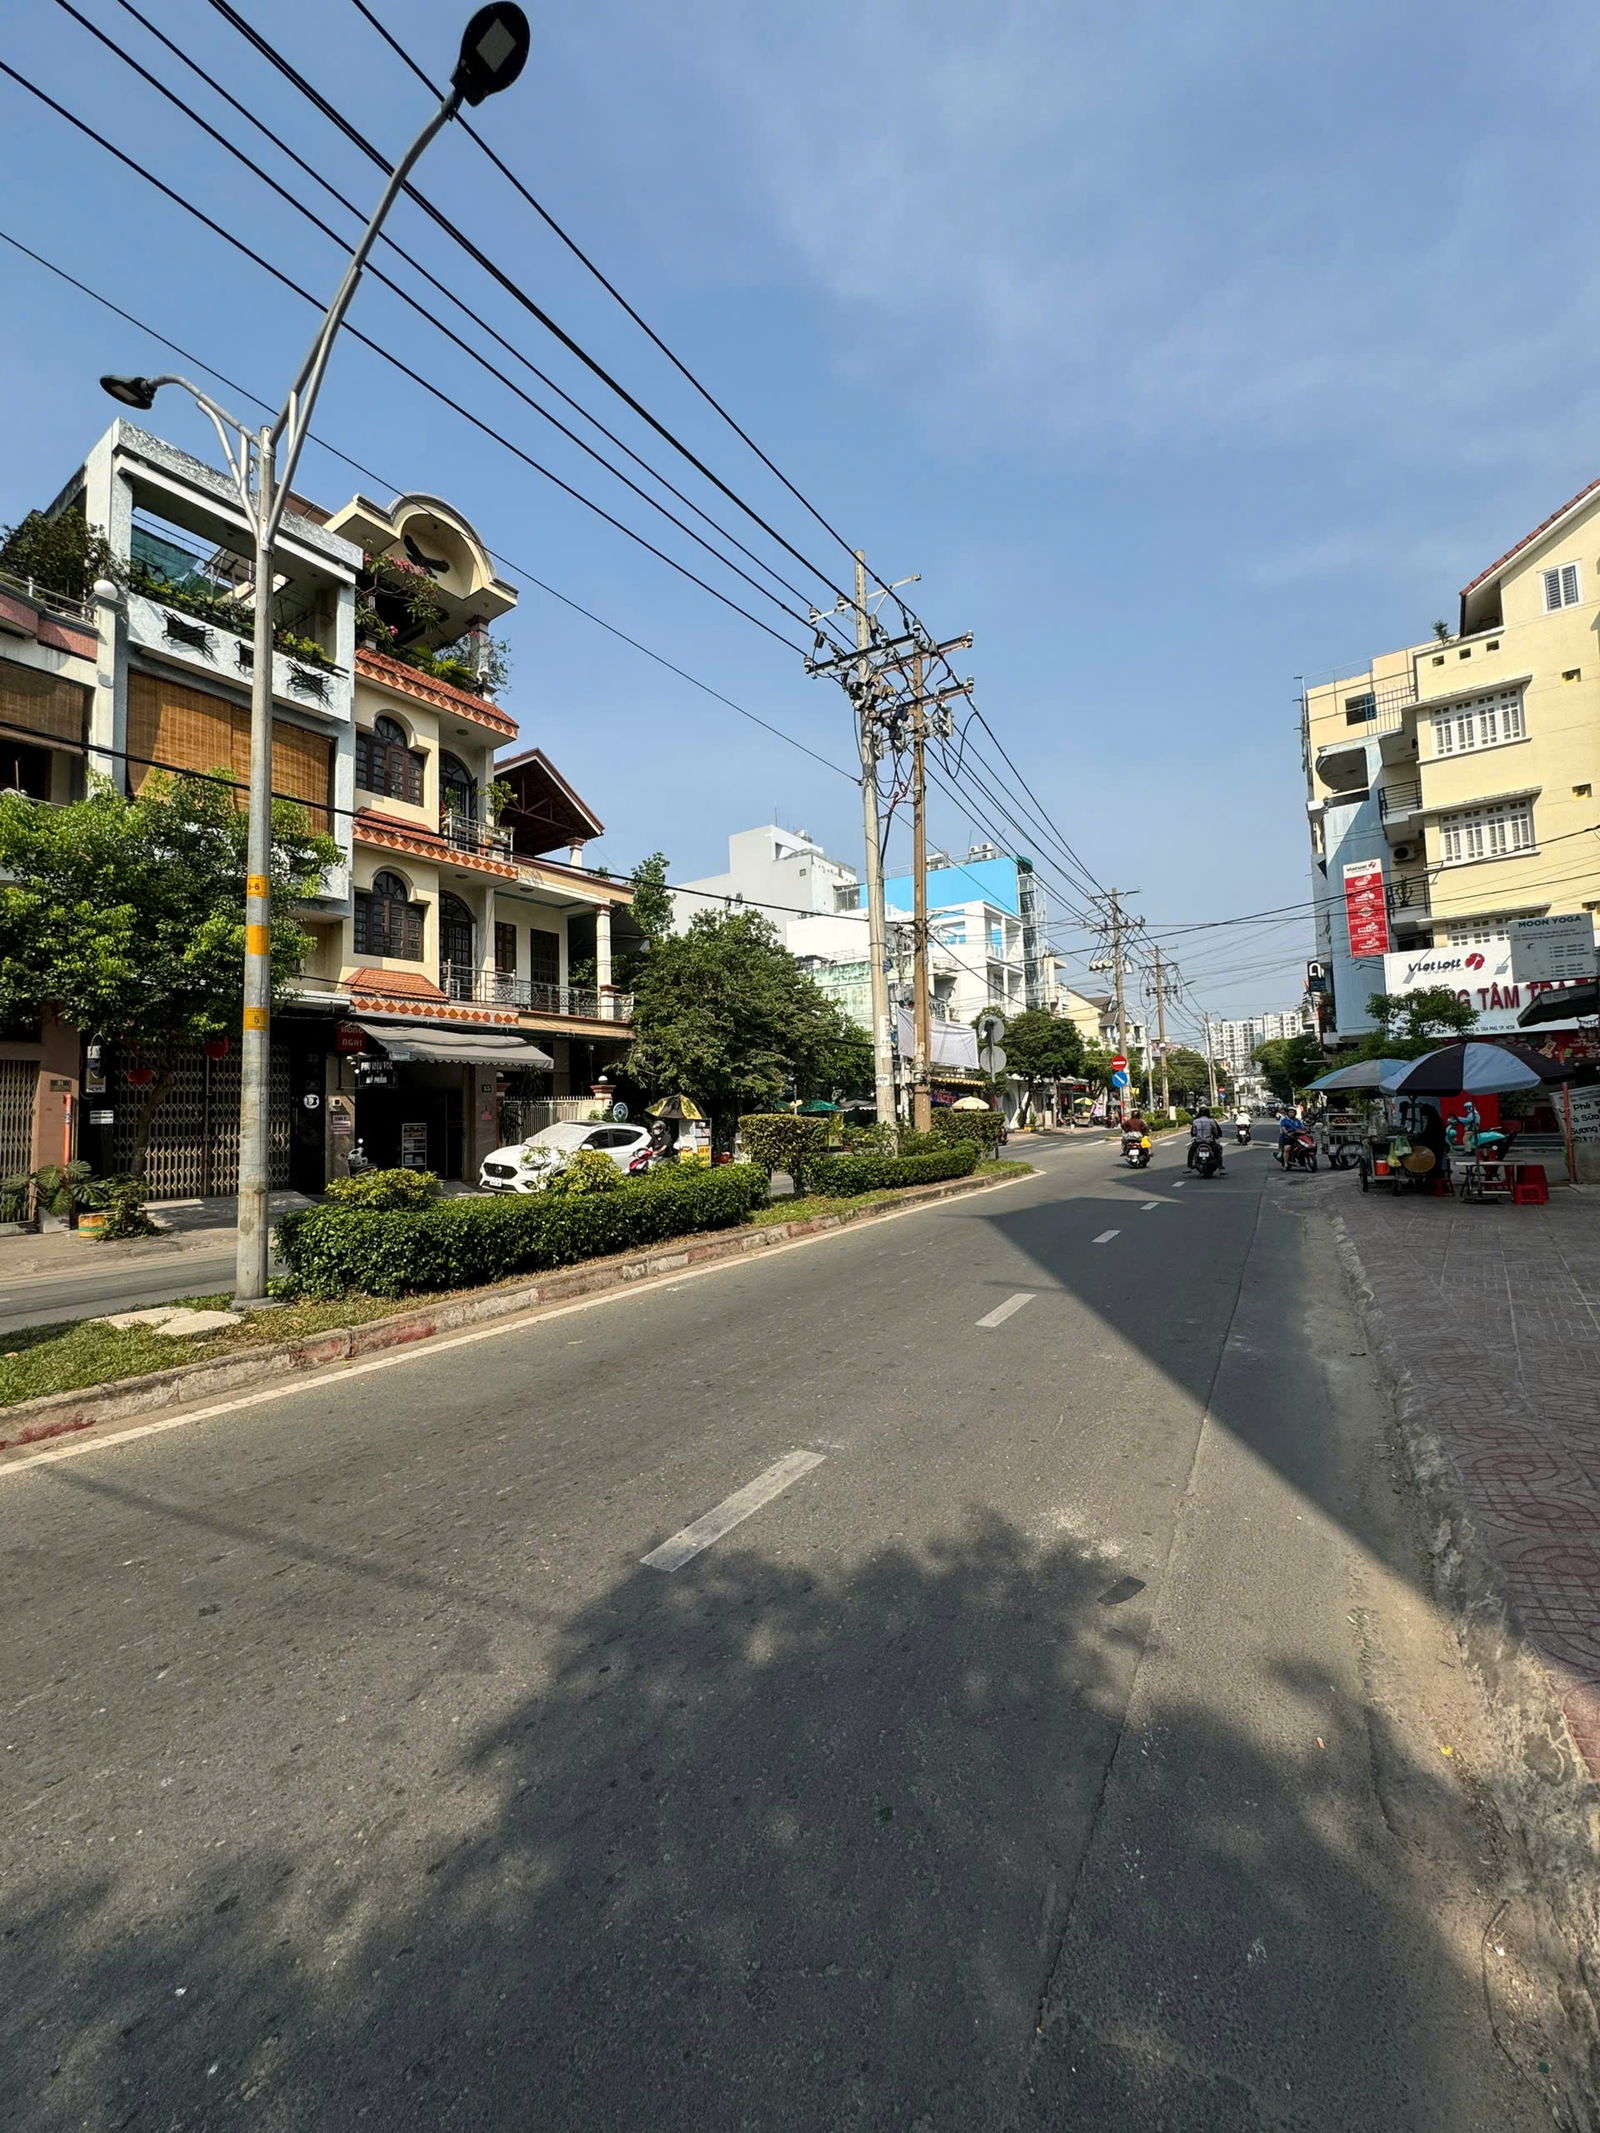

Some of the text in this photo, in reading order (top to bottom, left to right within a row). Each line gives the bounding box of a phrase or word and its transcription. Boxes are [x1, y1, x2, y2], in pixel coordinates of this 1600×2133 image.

[1518, 915, 1582, 928] MOON YOGA
[1477, 982, 1519, 1010] TÂM
